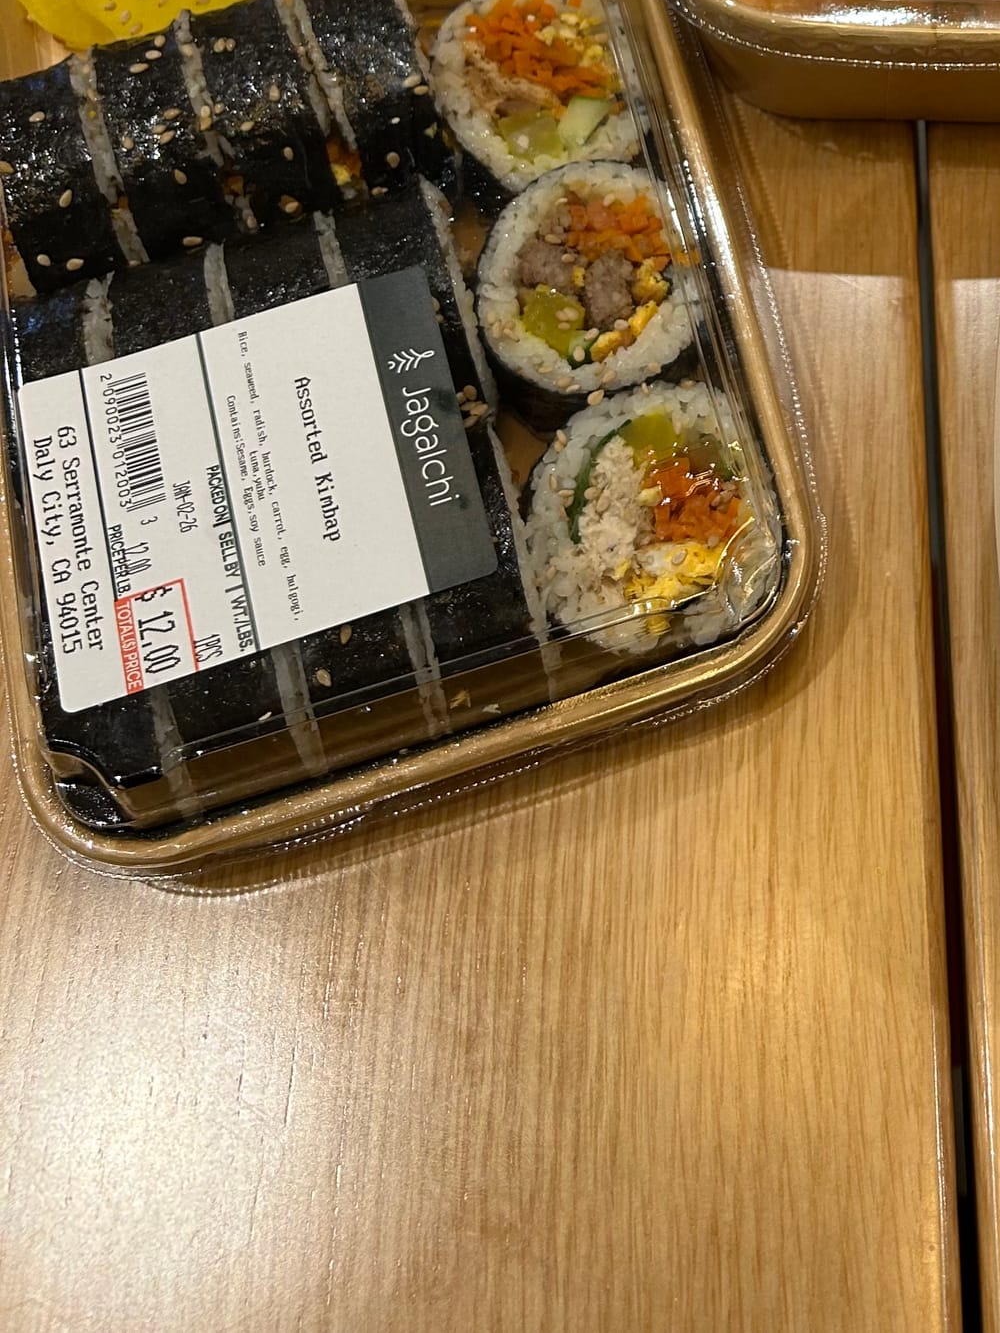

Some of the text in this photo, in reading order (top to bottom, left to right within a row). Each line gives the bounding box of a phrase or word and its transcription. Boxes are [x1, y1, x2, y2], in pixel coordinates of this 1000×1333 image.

[99, 373, 134, 508] 2 090023 012003
[236, 330, 303, 621] Rice, seaweed, radish, burdock, carrot, egg, bulgogi,
[293, 376, 340, 541] Assorted Kimbap
[400, 387, 459, 506] Jagalchi
[32, 435, 82, 654] Daly City, CA 94015
[57, 426, 103, 650] 63 Serramonte Center
[139, 515, 158, 525] 3
[172, 480, 198, 533] JAN-02-26
[253, 536, 265, 567] sauce
[107, 523, 131, 596] PRICE PER LB.
[120, 542, 151, 577] 12.00
[205, 464, 253, 652] PACKED ON SELL BY WT./LBS.
[116, 600, 142, 690] TOTAL($) PRICE
[134, 585, 180, 674] $ 12.00
[190, 633, 223, 666] 1PCS
